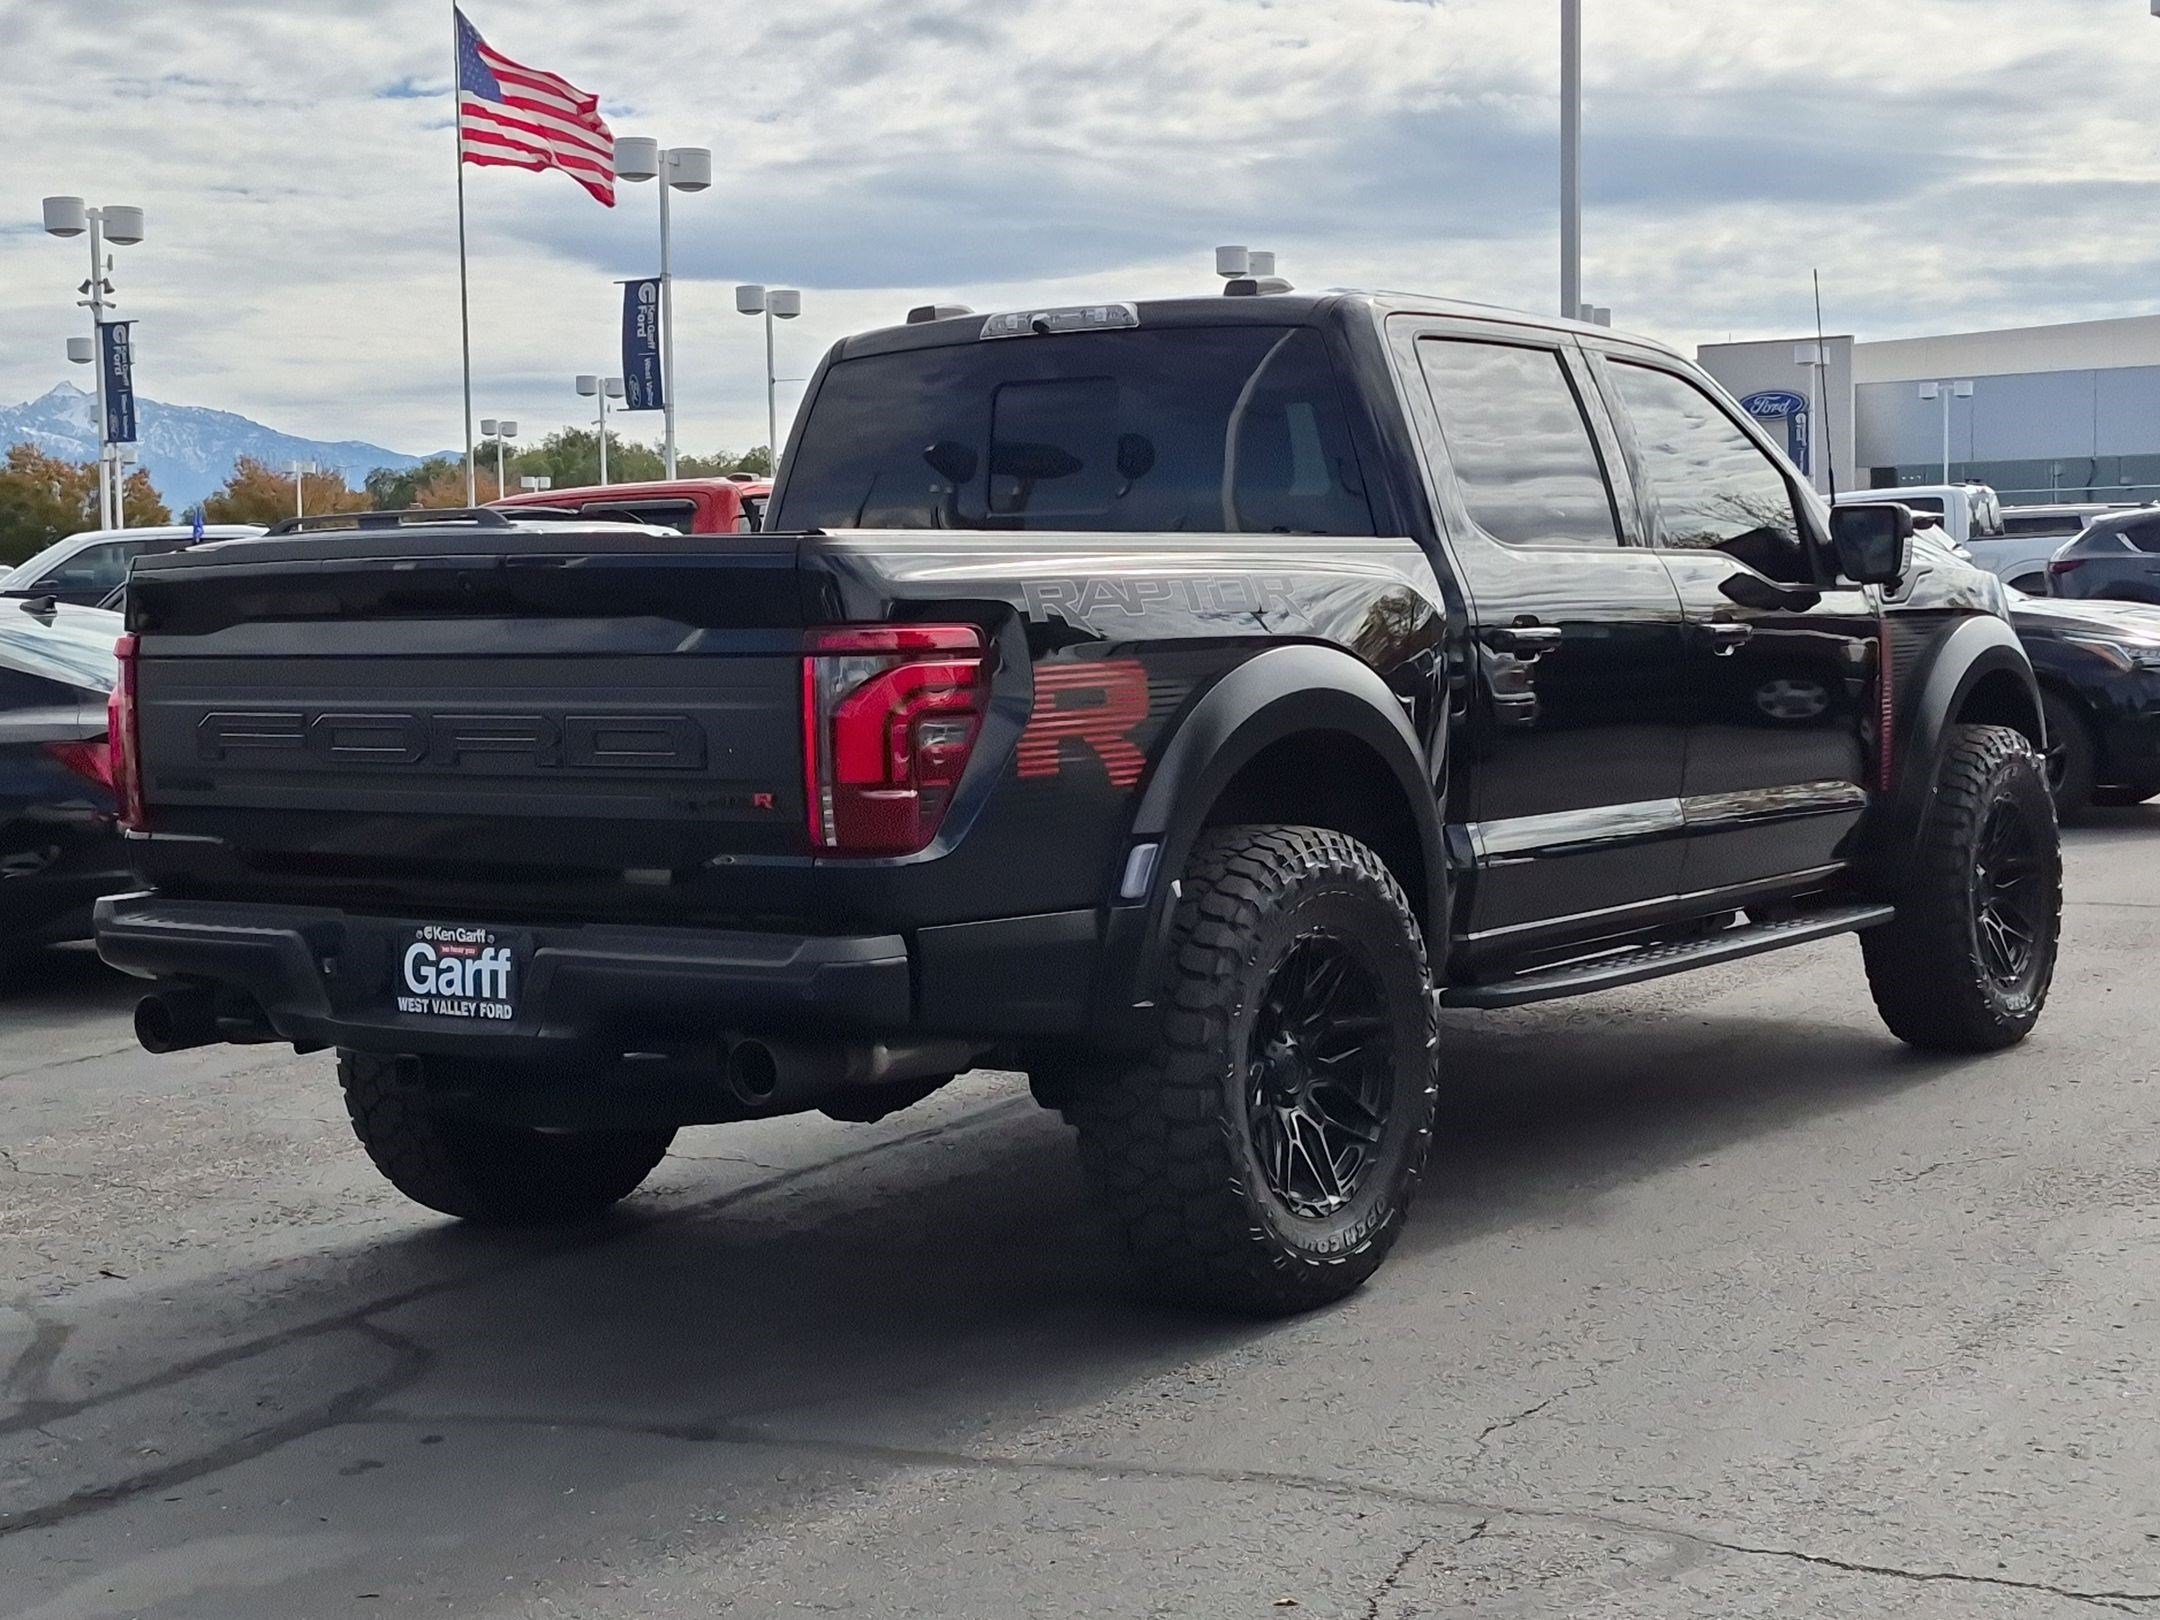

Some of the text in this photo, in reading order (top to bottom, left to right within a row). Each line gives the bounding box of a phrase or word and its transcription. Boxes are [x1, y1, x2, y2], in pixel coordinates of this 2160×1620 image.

[637, 305, 647, 338] Ford
[1750, 395, 1792, 414] Ford
[1020, 575, 1315, 639] RAPTOR
[198, 711, 708, 771] FORD
[1017, 660, 1149, 788] R
[433, 926, 456, 941] Ken
[456, 927, 487, 943] Garff
[404, 942, 512, 999] Garff
[397, 996, 513, 1020] WEST VALLEY FORD
